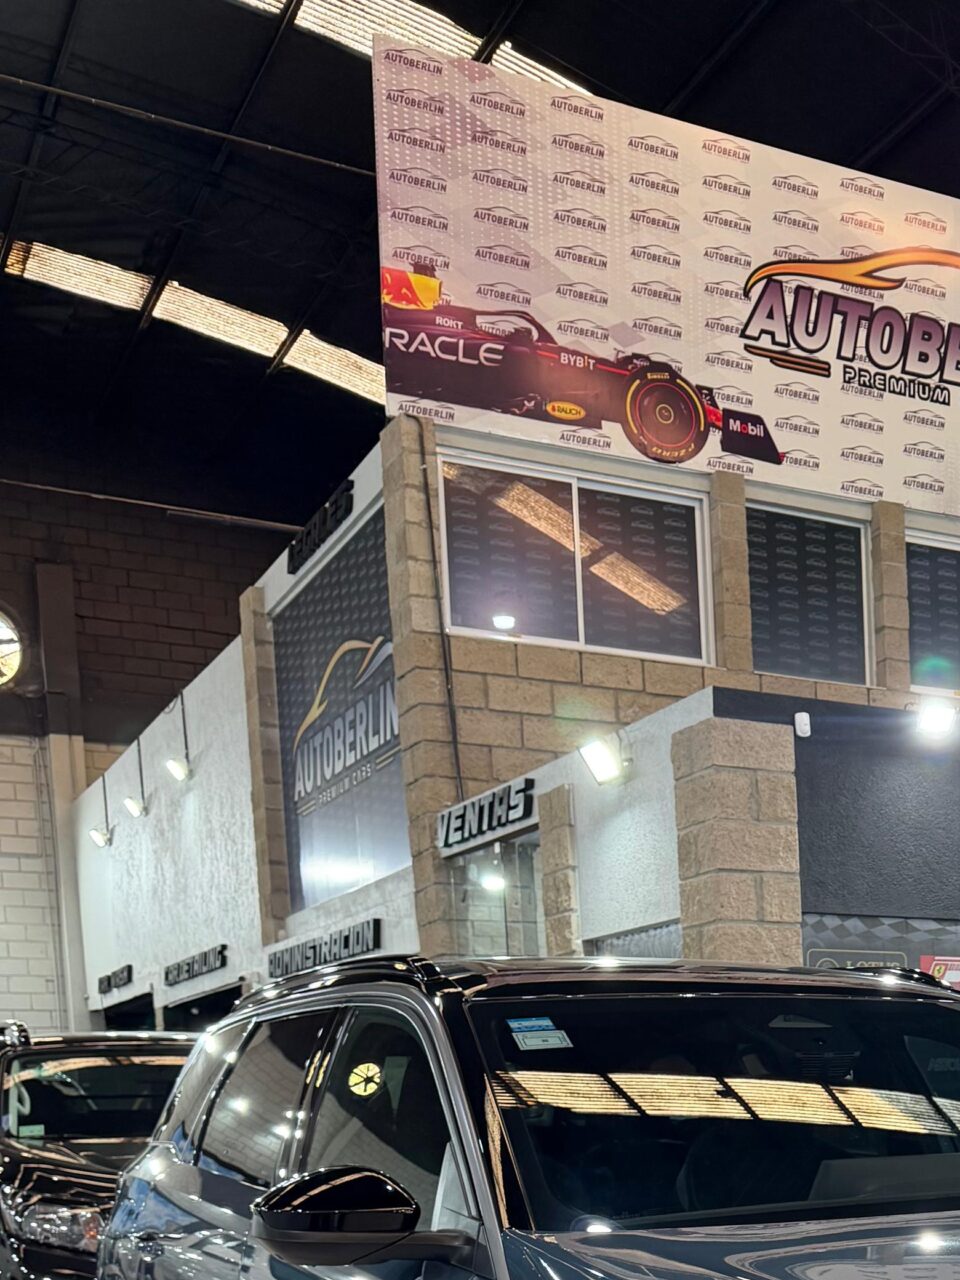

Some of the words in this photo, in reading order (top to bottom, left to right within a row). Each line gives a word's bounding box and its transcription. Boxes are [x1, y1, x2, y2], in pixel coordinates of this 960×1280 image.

[384, 52, 443, 75] AUTOBERLIN
[386, 92, 445, 114] AUTOBERLIN
[470, 95, 525, 117] AUTOBERLIN
[550, 100, 604, 121] AUTOBERLIN
[387, 132, 446, 153] AUTOBERLIN
[471, 134, 527, 155] AUTOBERLIN
[552, 137, 604, 158] AUTOBERLIN
[628, 139, 679, 160] AUTOBERLIN
[702, 142, 750, 162] AUTOBERLIN
[389, 171, 447, 192] AUTOBERLIN
[472, 172, 527, 193] AUTOBERLIN
[553, 175, 606, 195] AUTOBERLIN
[629, 175, 679, 195] AUTOBERLIN
[703, 178, 750, 198] AUTOBERLIN
[772, 179, 818, 198] AUTOBERLIN
[840, 180, 884, 200] AUTOBERLIN
[390, 210, 448, 231] AUTOBERLIN
[474, 211, 529, 231] AUTOBERLIN
[554, 213, 607, 232] AUTOBERLIN
[629, 212, 680, 231] AUTOBERLIN
[703, 215, 751, 233] AUTOBERLIN
[773, 214, 819, 232] AUTOBERLIN
[840, 215, 884, 234] AUTOBERLIN
[904, 215, 946, 234] AUTOBERLIN
[475, 249, 530, 268] AUTOBERLIN
[555, 250, 608, 269] AUTOBERLIN
[630, 248, 680, 267] AUTOBERLIN
[704, 251, 751, 268] AUTOBERLIN
[476, 287, 531, 306] AUTOBERLIN
[556, 287, 608, 306] AUTOBERLIN
[631, 285, 681, 303] AUTOBERLIN
[904, 280, 946, 299] AUTOBERLIN
[436, 316, 464, 330] ROKT
[557, 323, 609, 342] AUTOBERLIN
[632, 322, 682, 339] AUTOBERLIN
[704, 321, 740, 335] AUTOBER
[384, 327, 505, 367] RACLE
[560, 352, 596, 371] BYBIT
[705, 355, 753, 371] AUTOBERLIN
[774, 387, 819, 402] AUTOBERLIN
[843, 366, 950, 406] PREMIUM
[713, 392, 753, 406] UTOBERLIN
[398, 403, 455, 421] AUTOBERLIN
[556, 405, 582, 417] RAUCH
[729, 419, 764, 438] Mobil
[775, 420, 819, 435] AUTOBERLIN
[841, 418, 884, 433] AUTOBERLIN
[903, 414, 945, 429] AUTOBERLIN
[559, 434, 611, 449] AUTOBERLIN
[785, 456, 820, 469] TOBERLIN
[841, 451, 884, 465] AUTOBERLIN
[903, 446, 945, 461] AUTOBERLIN
[707, 460, 753, 474] AUTOBERLIN
[841, 484, 883, 498] AUTOBERLIN
[903, 479, 944, 494] AUTOBERLIN
[293, 679, 399, 802] AUTOBERLIN
[439, 778, 535, 848] VENTAS
[268, 918, 382, 978] ADMINISTRACION
